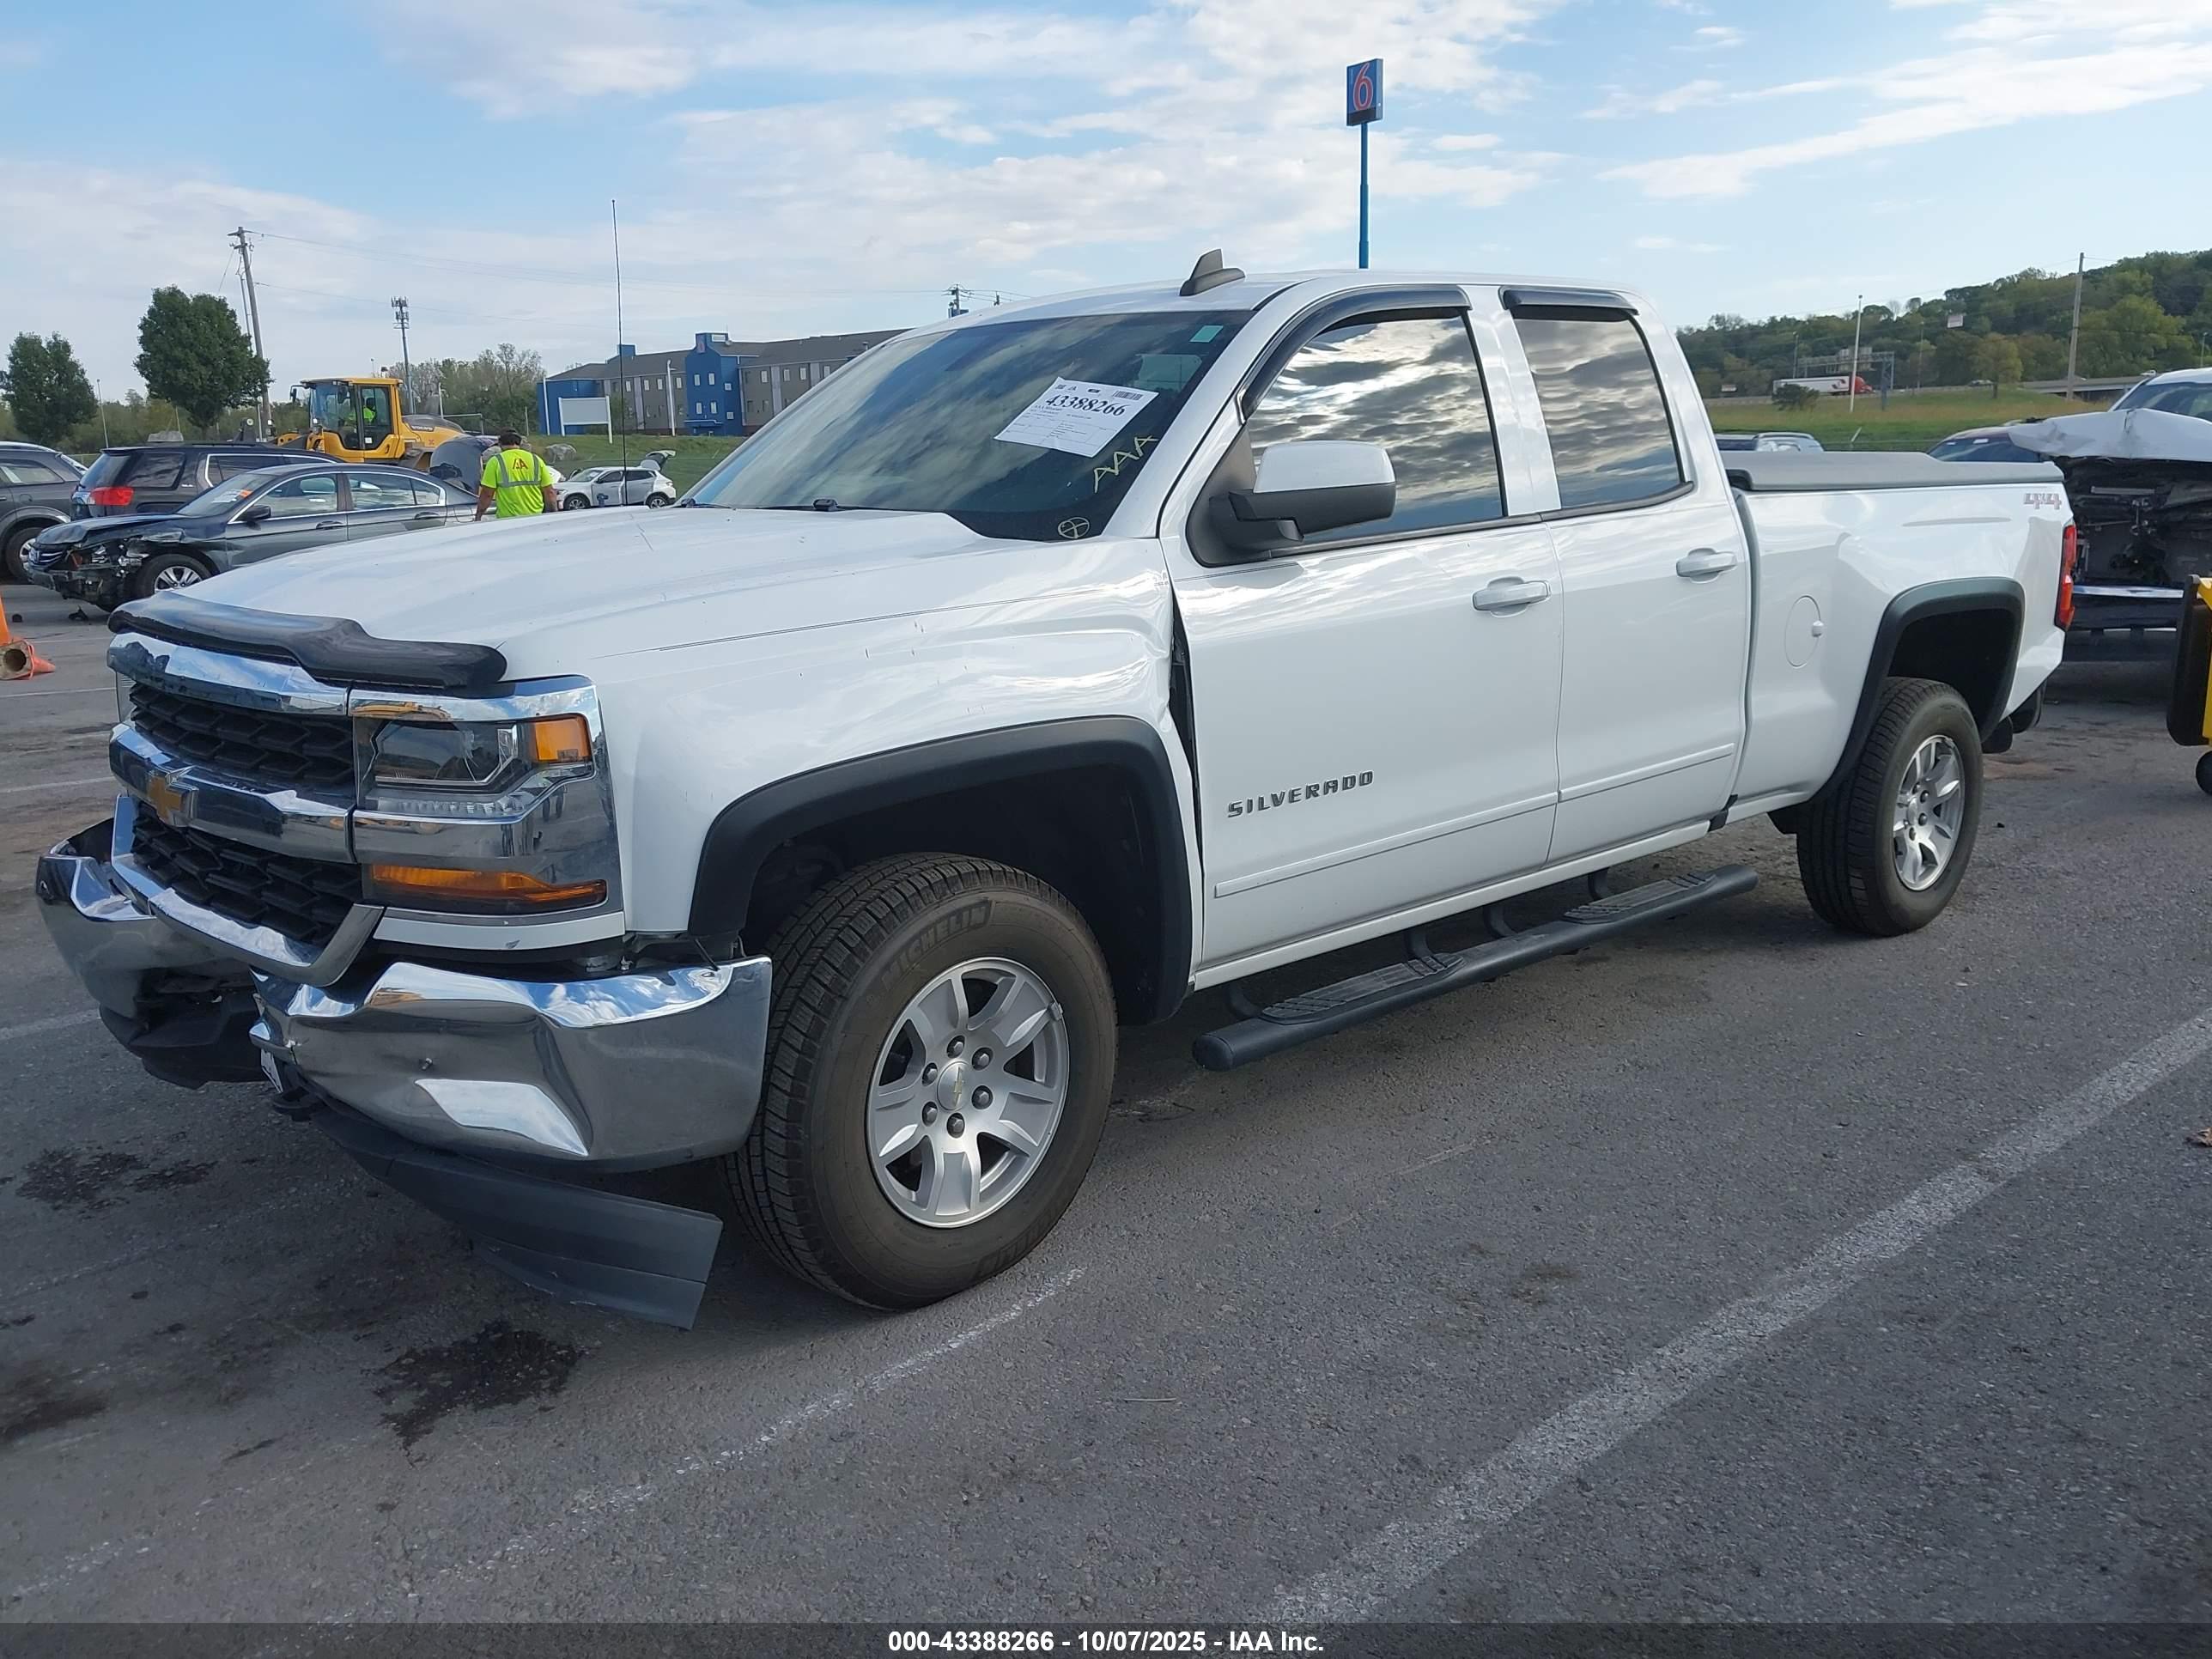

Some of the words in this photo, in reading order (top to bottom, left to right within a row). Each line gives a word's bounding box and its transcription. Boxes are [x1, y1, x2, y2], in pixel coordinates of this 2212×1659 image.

[1352, 62, 1374, 111] 6
[1045, 394, 1131, 416] 43388266
[1093, 435, 1159, 494] AAA
[1227, 770, 1374, 817] SILVERADO
[881, 904, 987, 991] MICHELIN
